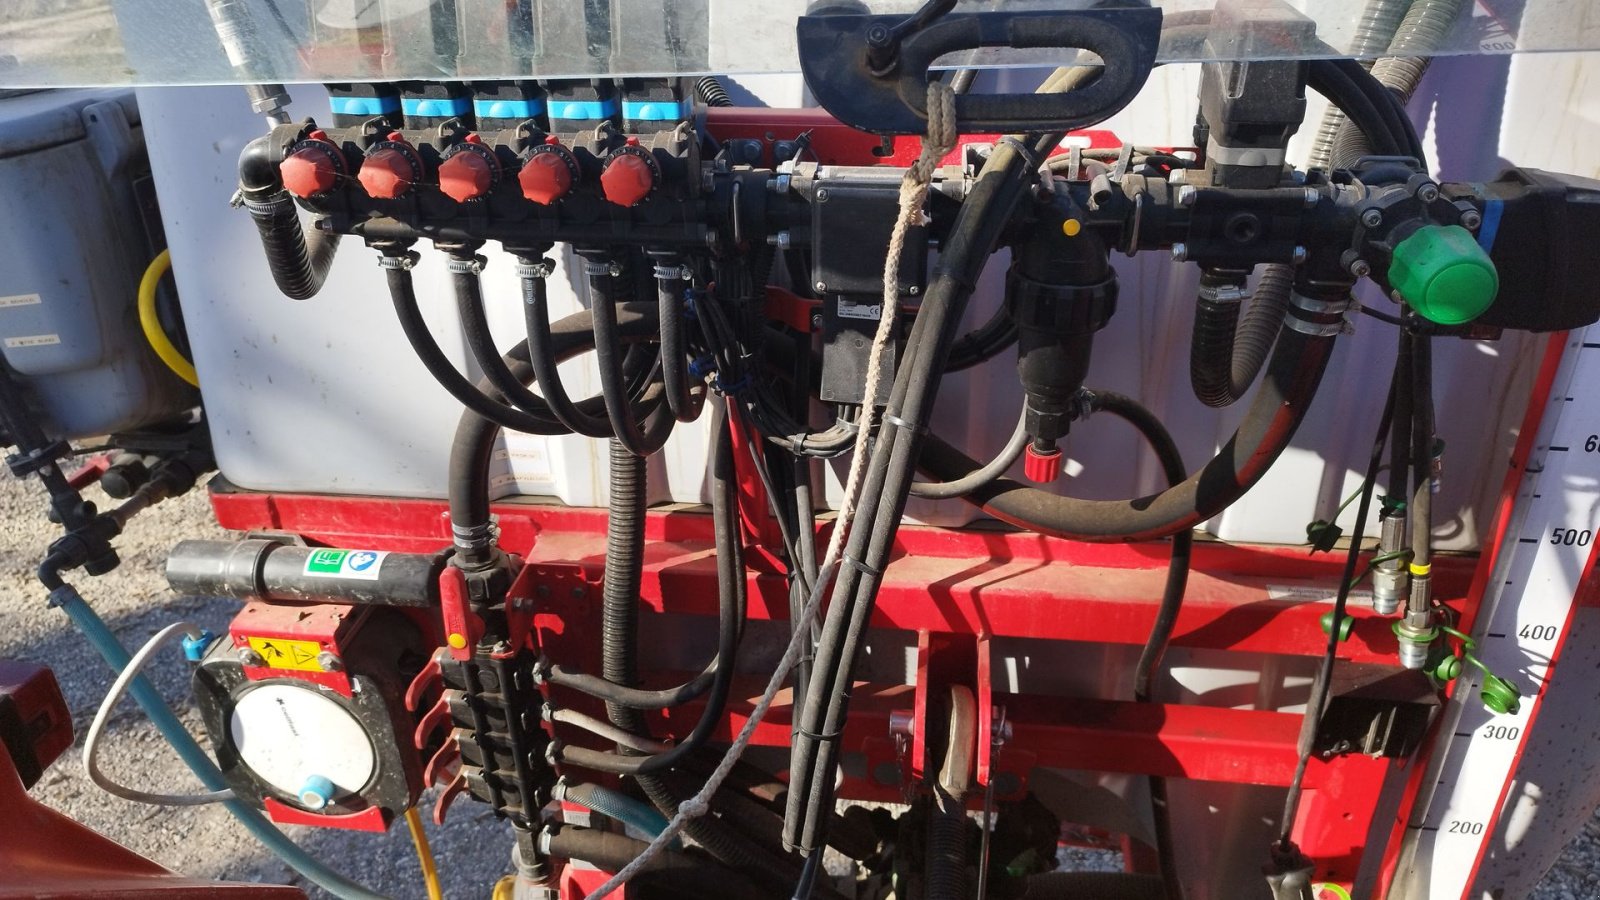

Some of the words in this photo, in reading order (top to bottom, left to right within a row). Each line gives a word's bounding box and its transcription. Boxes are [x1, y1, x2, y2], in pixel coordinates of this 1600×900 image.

[1584, 434, 1600, 453] 6
[1550, 527, 1592, 547] 500
[1518, 624, 1557, 641] 400
[1483, 725, 1520, 741] 300
[1448, 820, 1484, 835] 200
